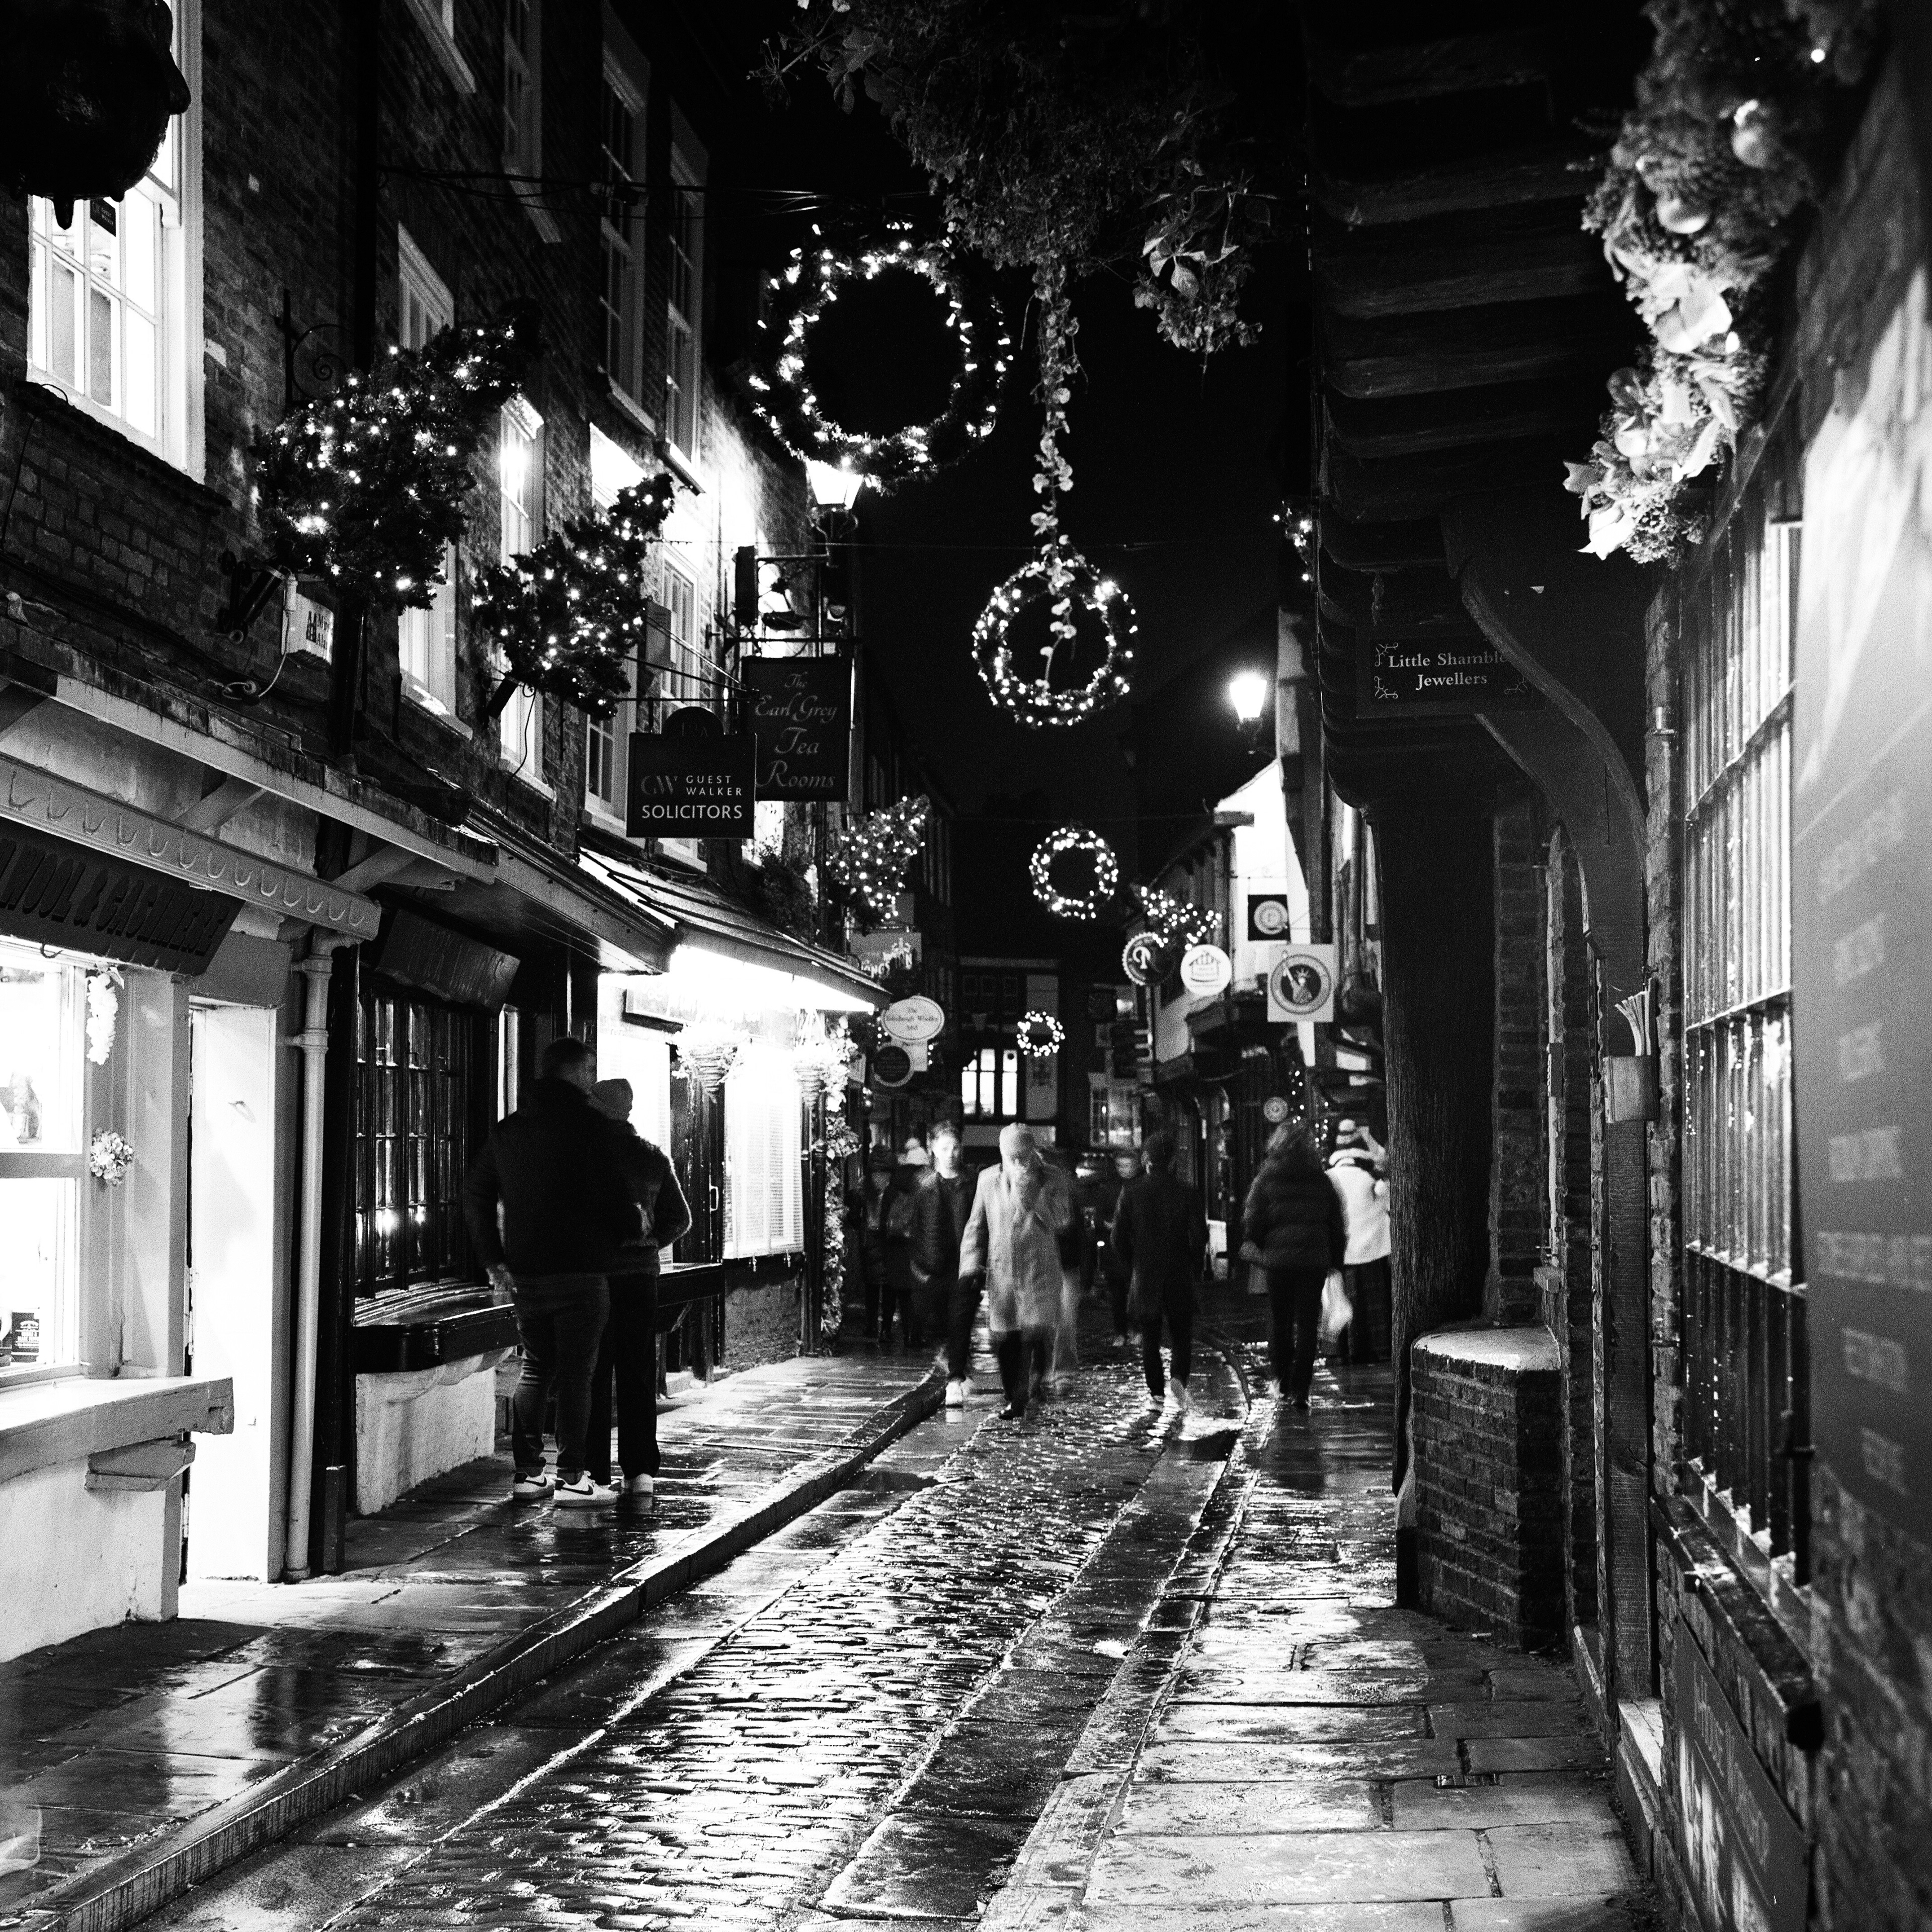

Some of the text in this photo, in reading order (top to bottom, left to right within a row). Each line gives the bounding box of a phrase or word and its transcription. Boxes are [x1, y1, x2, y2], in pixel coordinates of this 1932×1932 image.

[1389, 653, 1431, 668] Little
[784, 672, 808, 688] The
[1415, 672, 1488, 690] Jewellers
[755, 692, 838, 723] Earl Grey
[774, 727, 820, 754] Tea
[686, 775, 731, 784] GUEST
[755, 760, 835, 787] Rooms
[686, 787, 742, 795] WALKER
[642, 805, 743, 819] SOLICITORS
